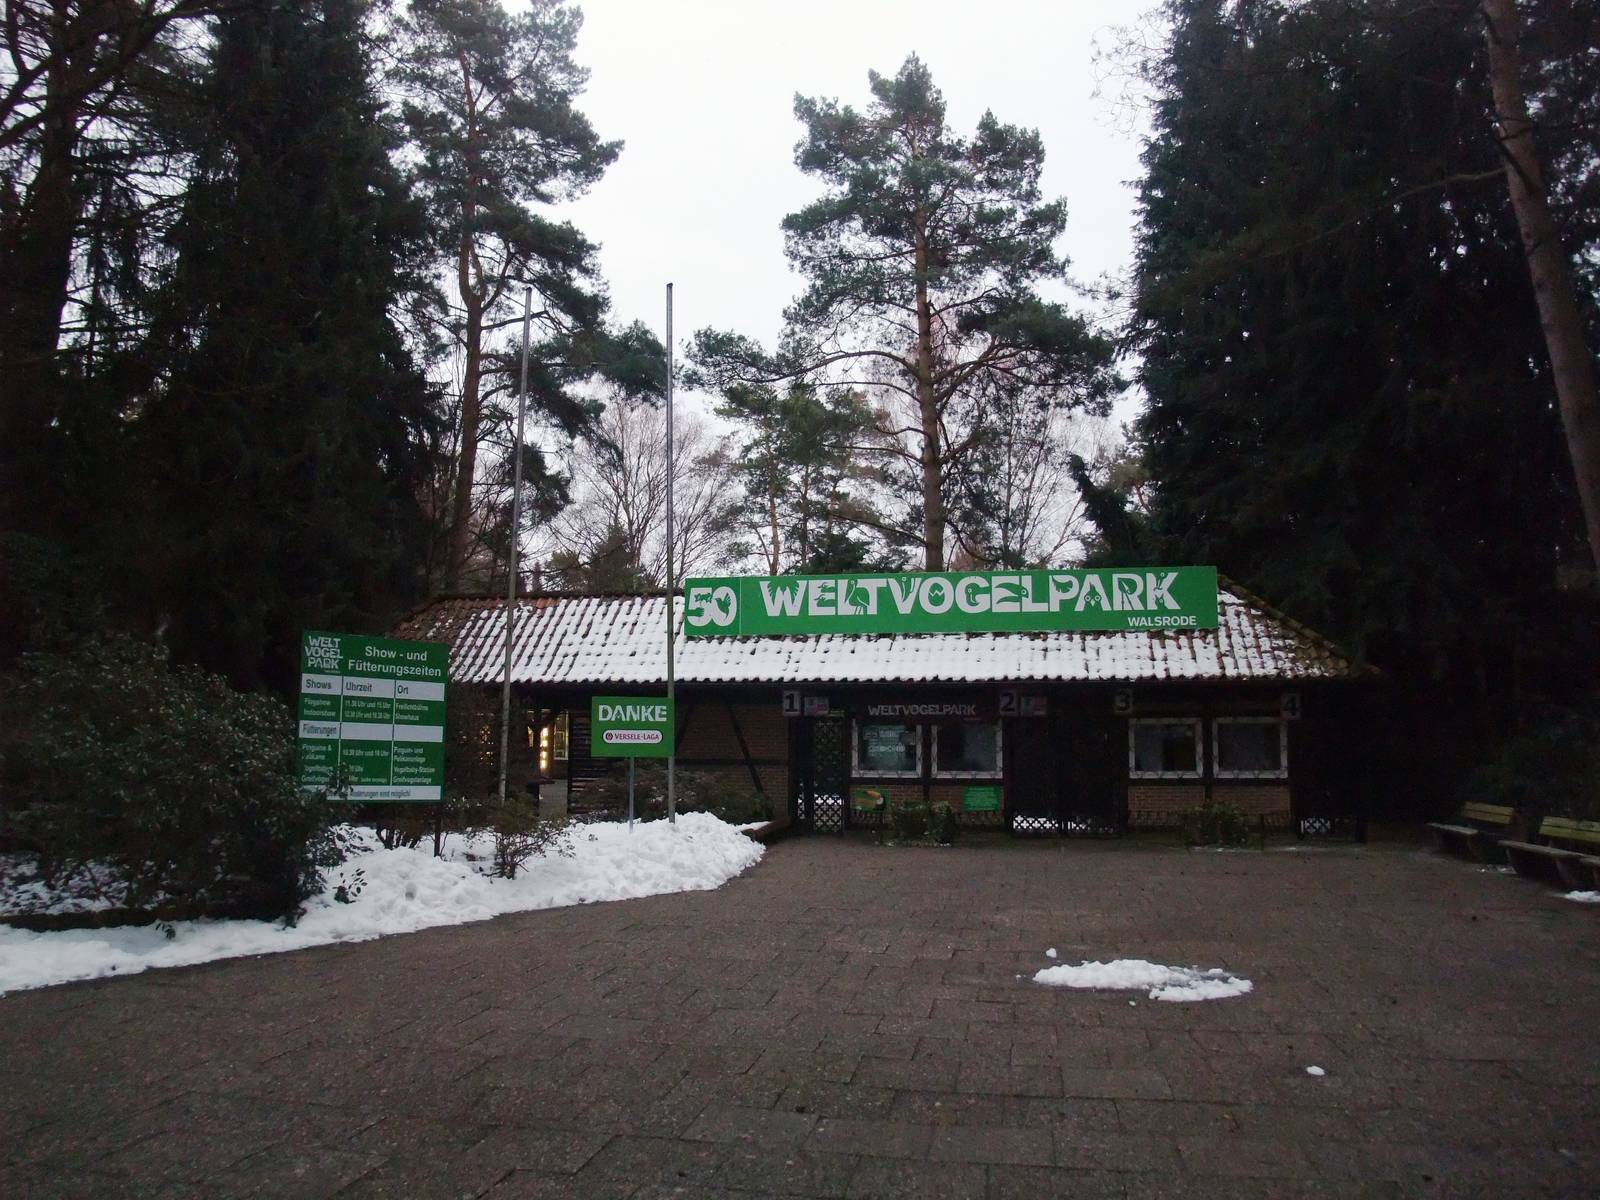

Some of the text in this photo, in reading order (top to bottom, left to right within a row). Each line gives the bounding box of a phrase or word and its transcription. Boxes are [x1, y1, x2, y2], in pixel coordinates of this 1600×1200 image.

[687, 572, 1181, 626] 50 WELTVOGELPARK
[1127, 615, 1197, 626] WALSRODE
[308, 635, 341, 648] WELT
[305, 646, 344, 659] VOGEL
[365, 645, 396, 658] Show
[407, 650, 427, 662] und
[307, 657, 339, 670] PARK
[348, 660, 442, 677] Fütterungszeiten
[305, 678, 332, 690] Shows
[345, 680, 373, 692] Uhrzeit
[397, 684, 409, 695] Ort
[785, 693, 798, 712] 1
[1001, 692, 1015, 712] 2
[1116, 691, 1132, 711] 3
[1284, 697, 1300, 716] 4
[598, 704, 667, 722] DANKE
[867, 704, 976, 716] WELTVOGELPARK
[303, 723, 338, 737] Fütterungen
[614, 733, 660, 741] VERSELE-LAGA
